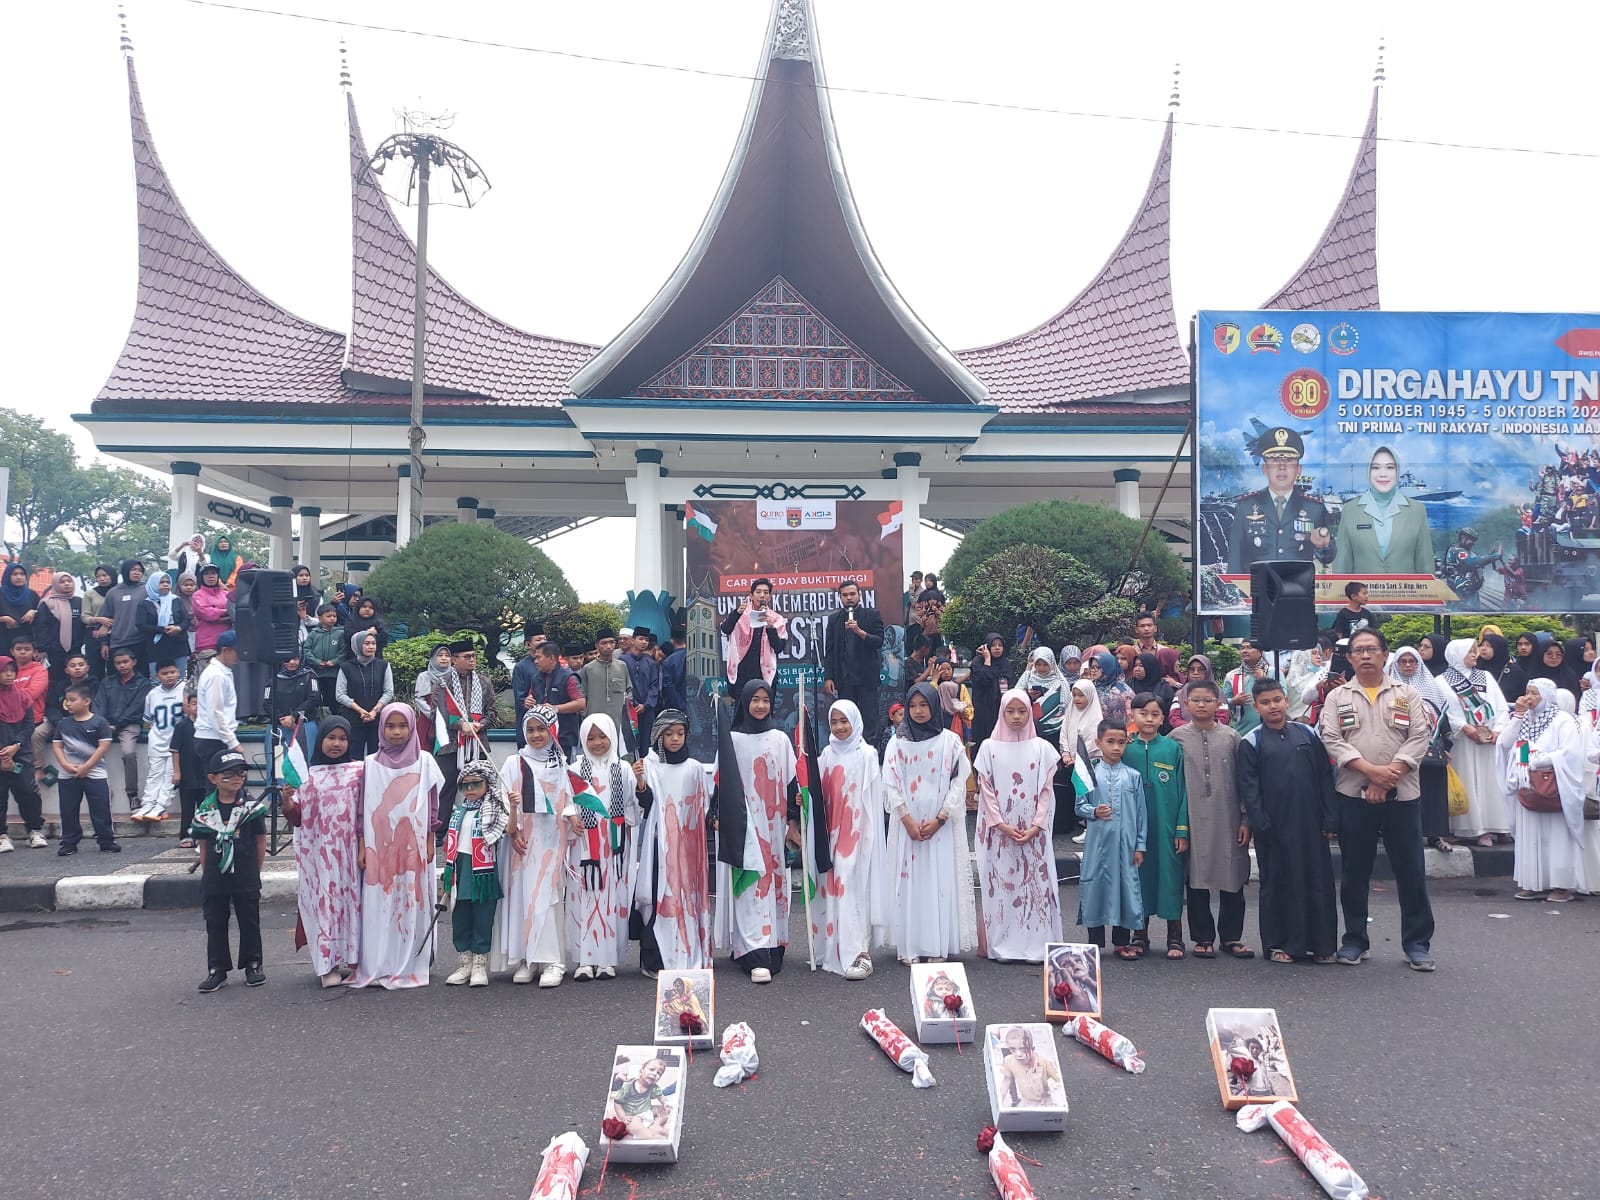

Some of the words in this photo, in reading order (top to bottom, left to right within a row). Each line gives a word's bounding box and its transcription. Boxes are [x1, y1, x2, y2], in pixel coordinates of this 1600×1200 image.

[1338, 368, 1541, 401] DIRGAHAYU
[1289, 378, 1321, 407] 80
[1338, 404, 1347, 417] 5
[1353, 404, 1423, 417] OKTOBER
[1430, 404, 1465, 418] 1945
[1483, 405, 1491, 418] 5
[1497, 405, 1566, 418] OKTOBER
[1338, 421, 1358, 433] TNI
[1362, 421, 1403, 433] PRIMA
[1416, 422, 1437, 433] TNI
[1440, 422, 1489, 433] RAKYAT
[1502, 423, 1570, 434] INDONESIA
[726, 578, 748, 588] CAR
[778, 577, 800, 586] DAY
[801, 574, 868, 585] BUKITTINGGI
